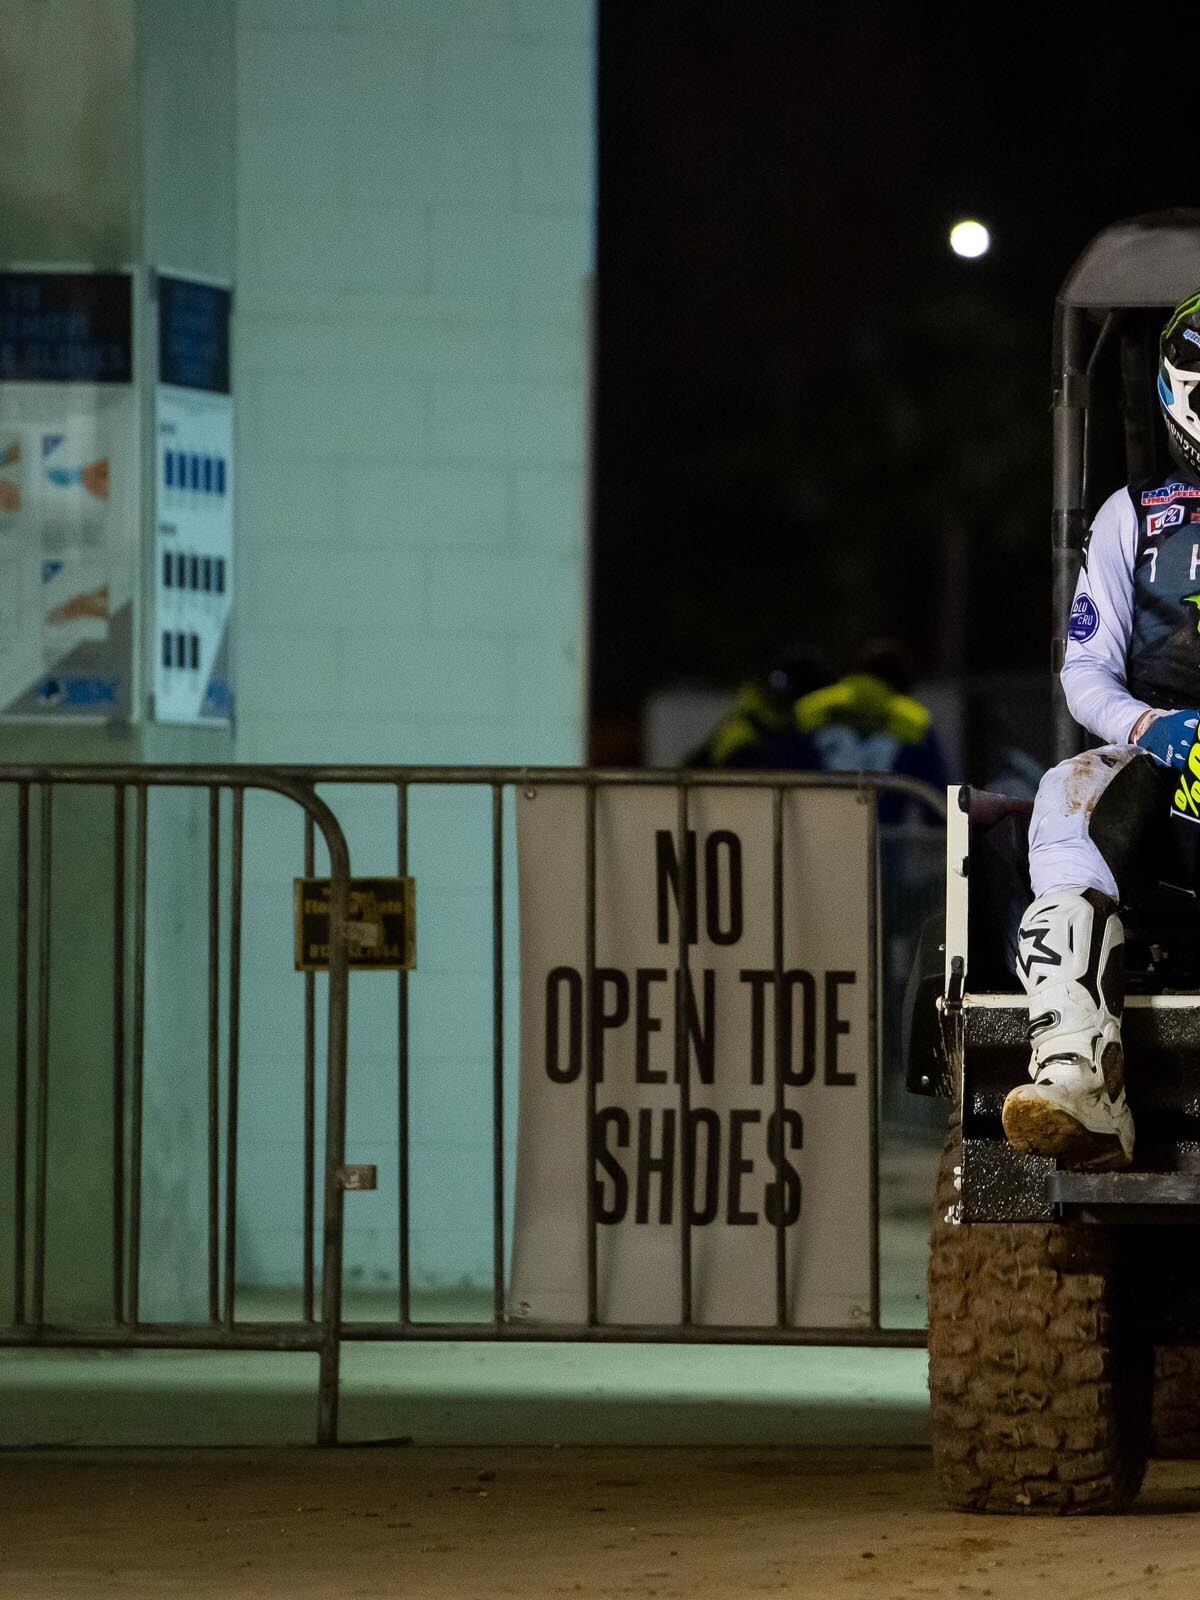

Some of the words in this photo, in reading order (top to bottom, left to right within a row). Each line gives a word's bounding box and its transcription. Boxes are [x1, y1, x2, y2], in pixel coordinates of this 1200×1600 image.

[654, 829, 743, 946] NO
[544, 966, 716, 1086] OPEN
[739, 968, 857, 1087] TOE
[593, 1106, 803, 1228] SHOES
